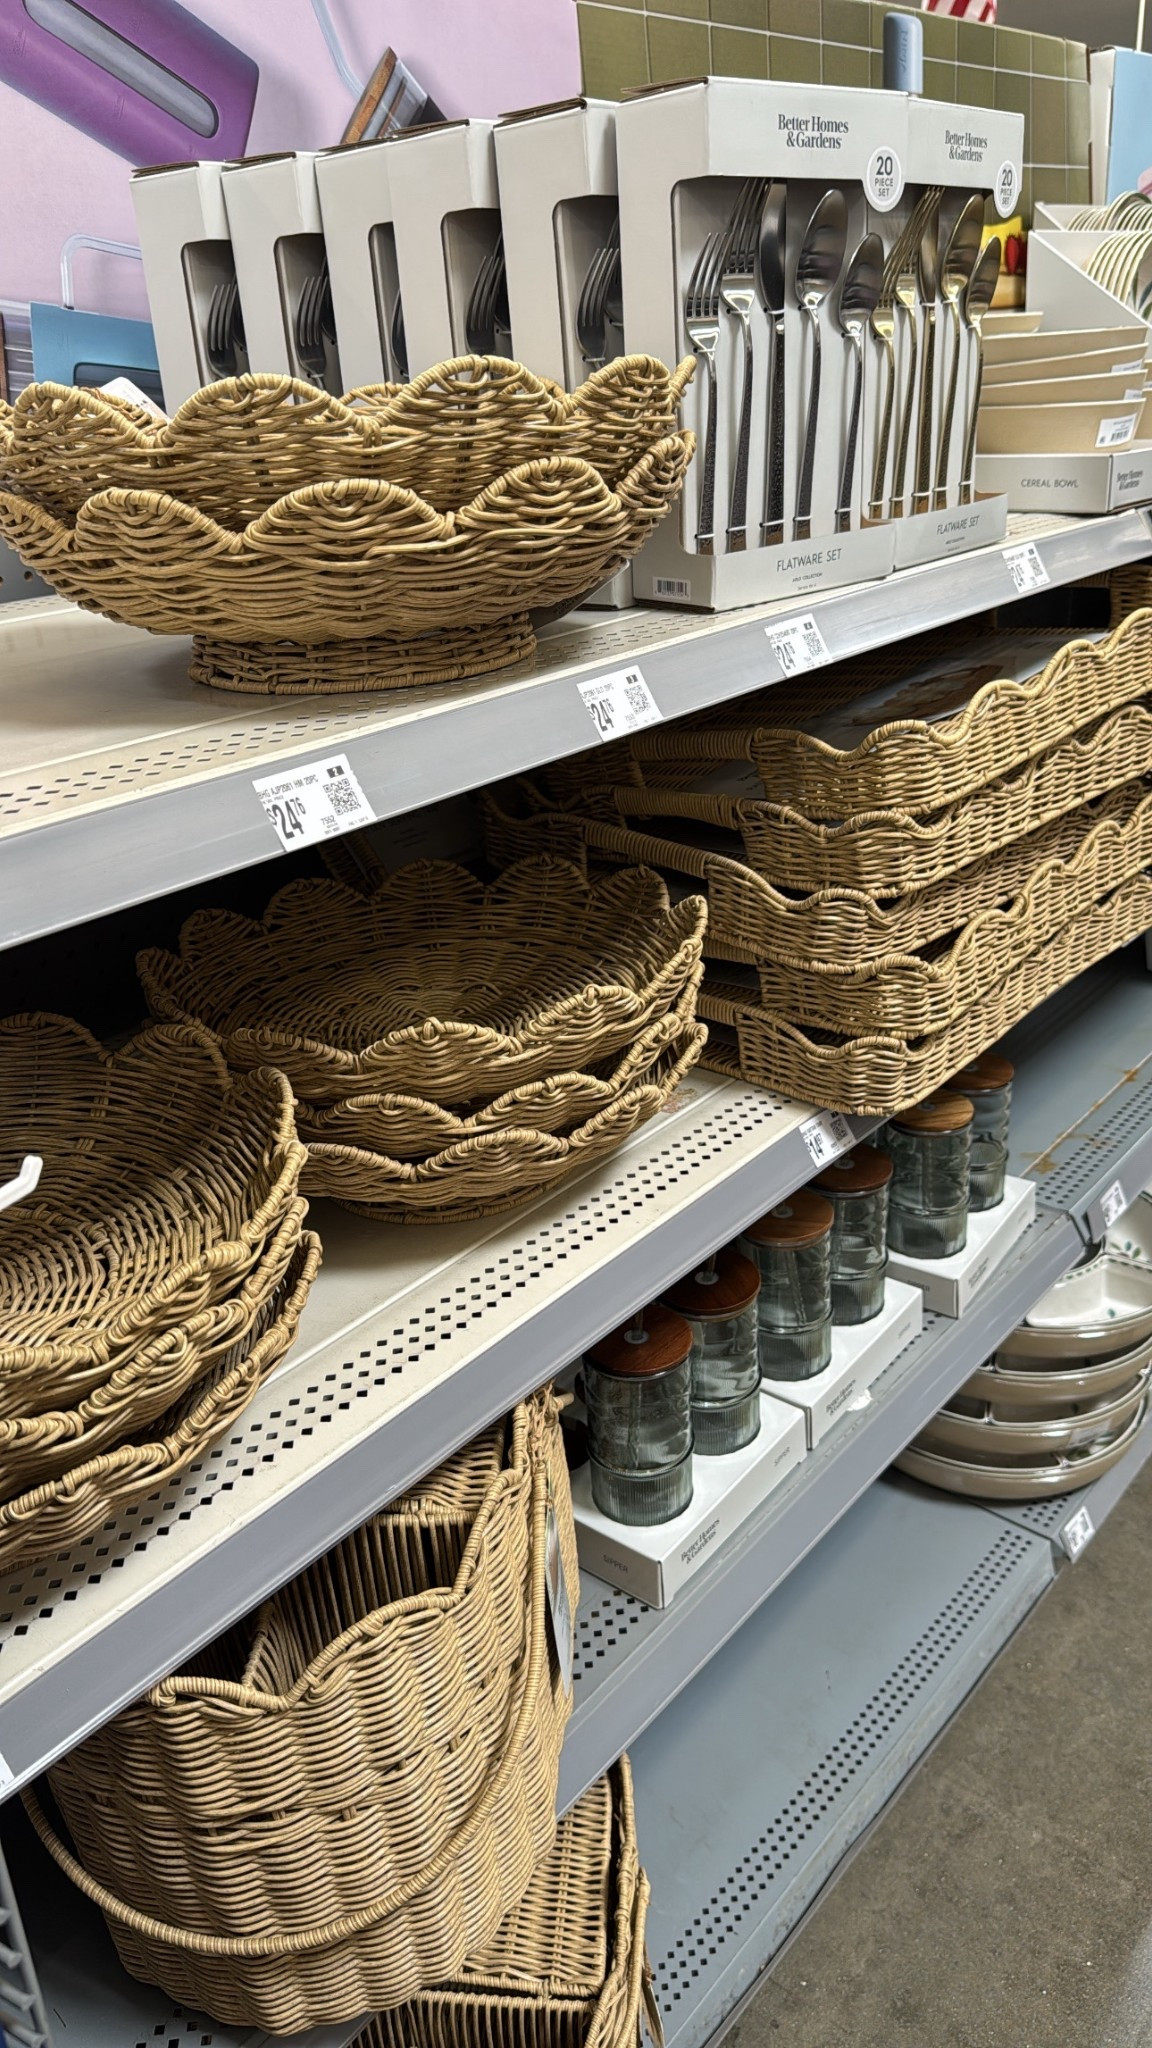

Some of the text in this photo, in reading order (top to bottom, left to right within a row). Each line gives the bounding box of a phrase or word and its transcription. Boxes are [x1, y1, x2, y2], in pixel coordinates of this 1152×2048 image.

[778, 114, 849, 133] Better Homes
[945, 130, 988, 148] Better Homes
[876, 156, 893, 176] 20
[874, 178, 894, 187] PIECE
[1002, 169, 1013, 186] 20
[878, 188, 890, 197] SET
[1000, 187, 1013, 196] PIECE
[1002, 196, 1010, 205] SET
[1021, 479, 1080, 488] CEREAL BOWL
[936, 515, 980, 536] FLATWARE SET
[776, 548, 842, 572] FLATWARE SET
[681, 1519, 720, 1561] Better Homes
[603, 1554, 629, 1573] SIPPER
